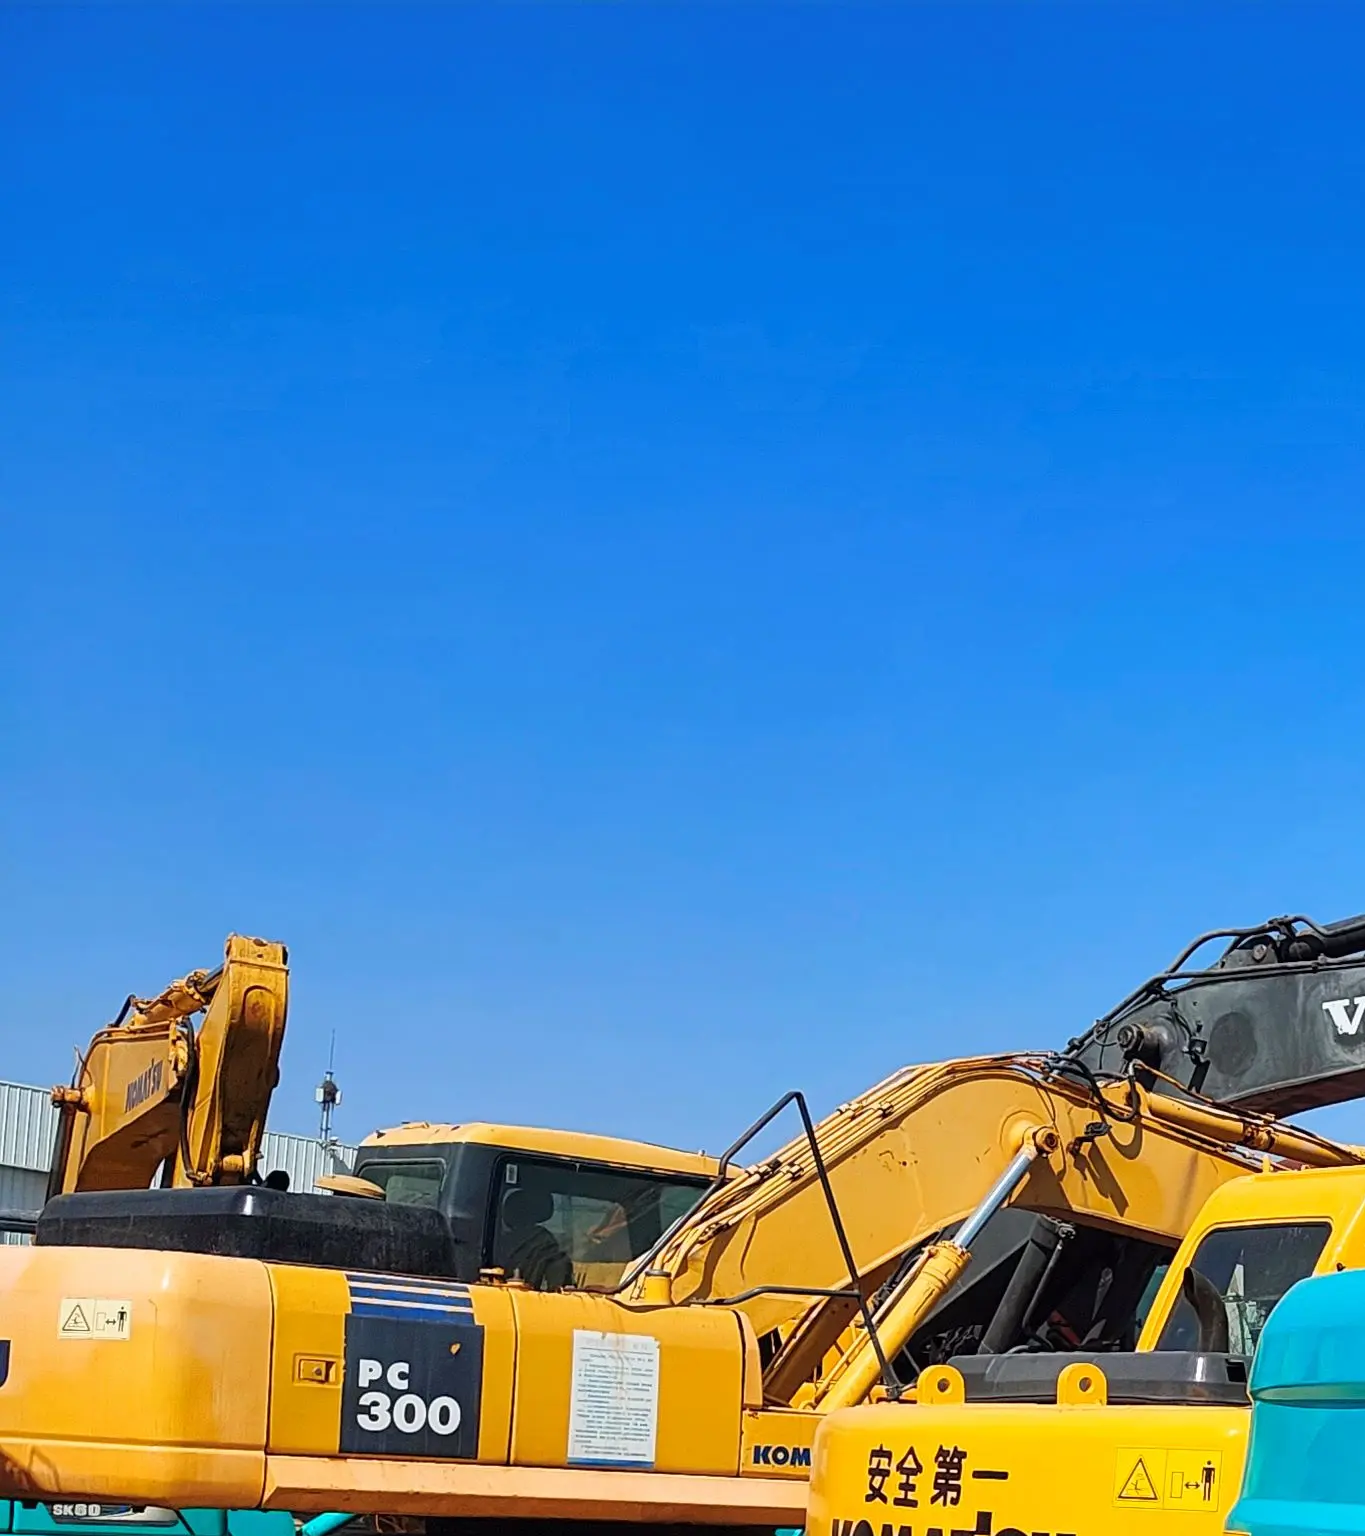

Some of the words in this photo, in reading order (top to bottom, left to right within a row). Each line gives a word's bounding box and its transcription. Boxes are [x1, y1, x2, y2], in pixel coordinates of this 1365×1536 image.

[358, 1359, 410, 1390] PC
[357, 1391, 461, 1435] 300
[865, 1444, 1009, 1508] 安全第一
